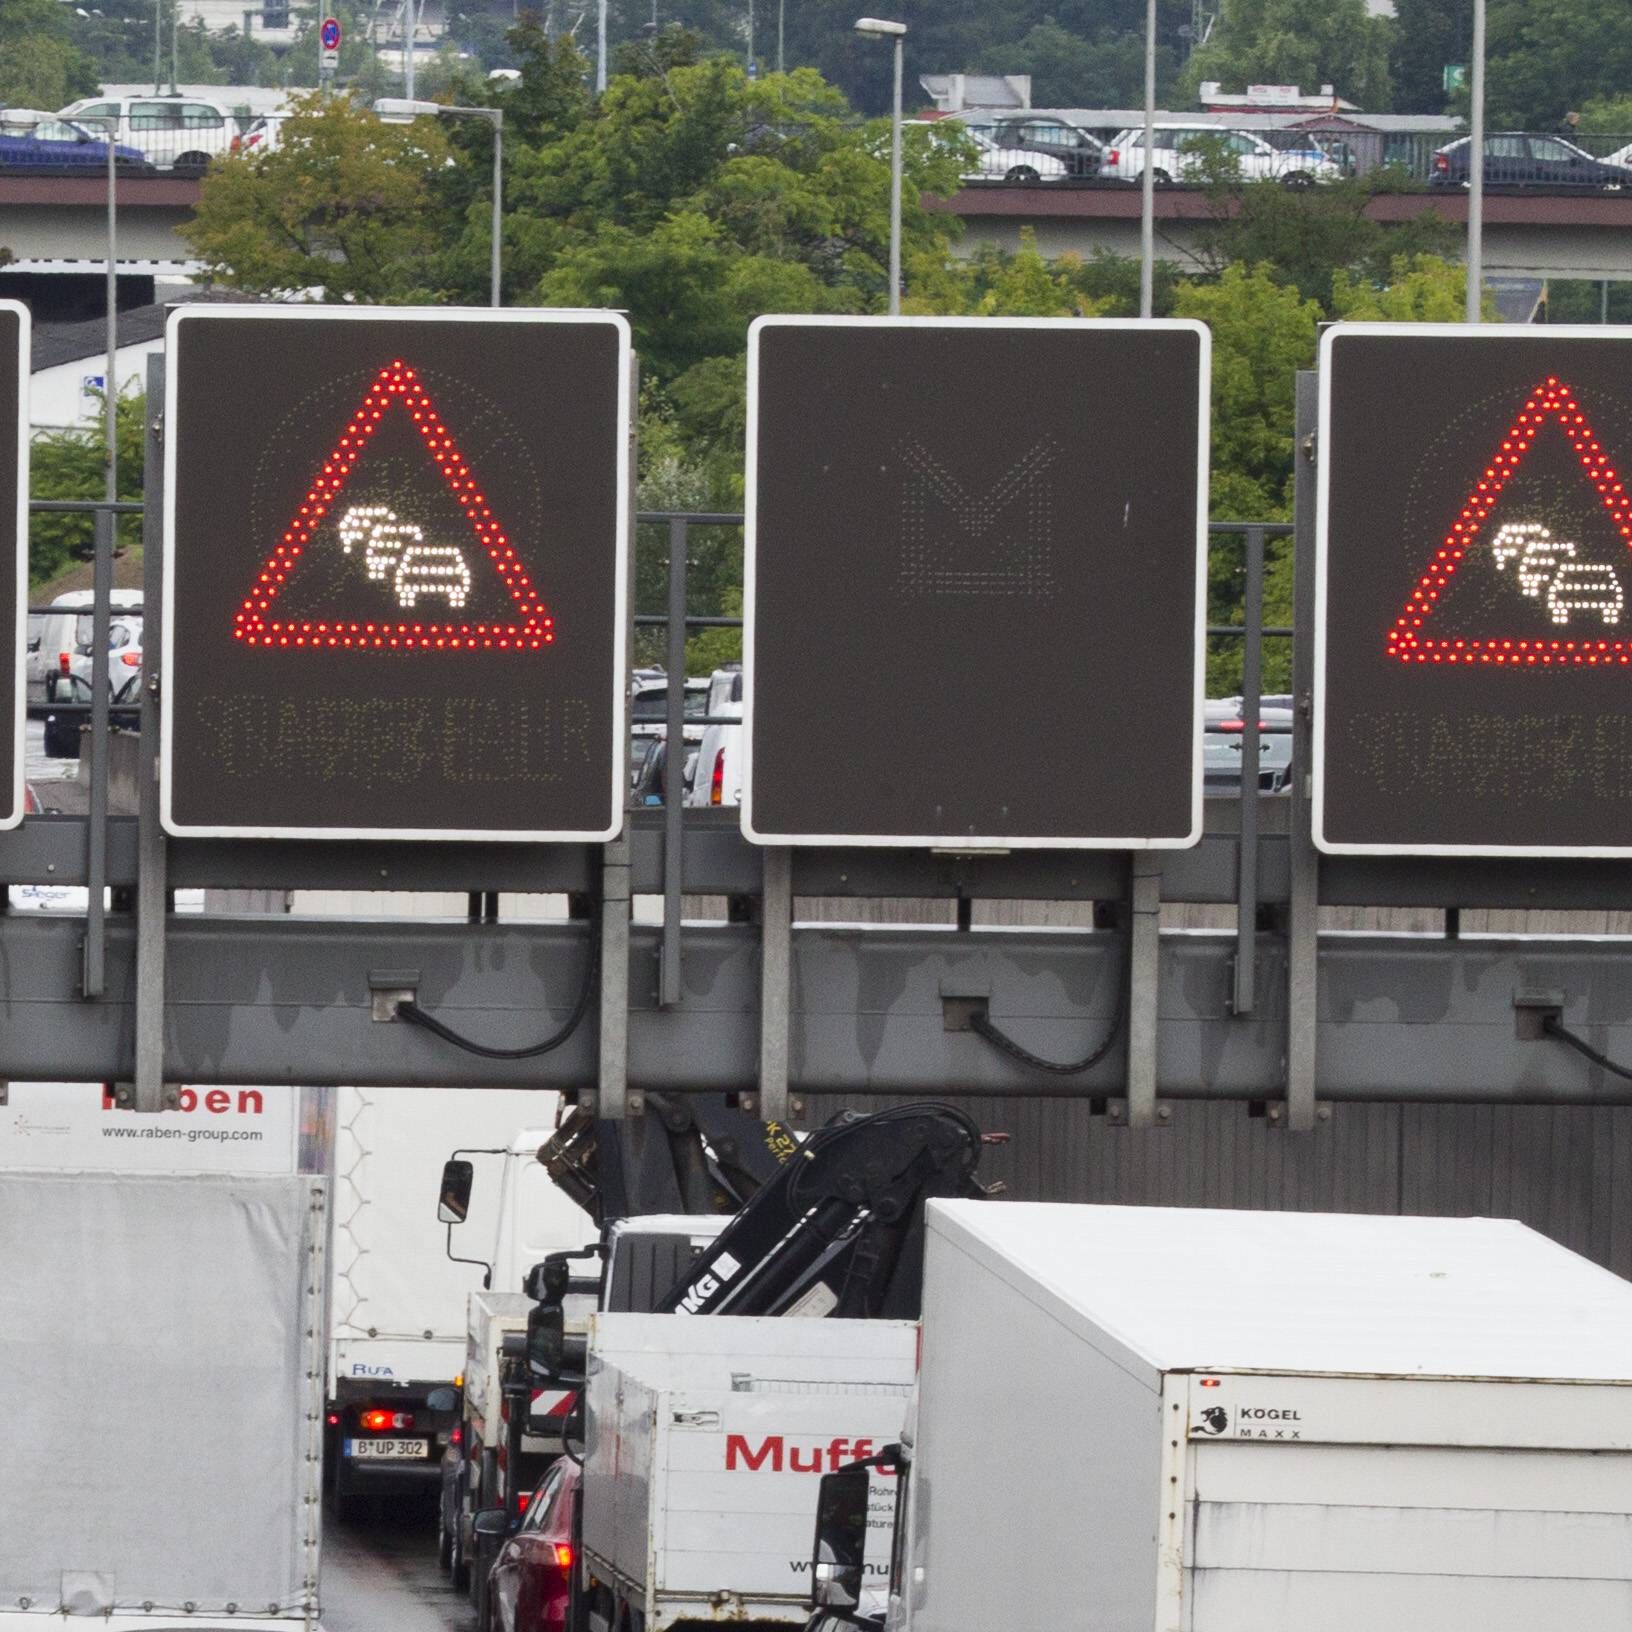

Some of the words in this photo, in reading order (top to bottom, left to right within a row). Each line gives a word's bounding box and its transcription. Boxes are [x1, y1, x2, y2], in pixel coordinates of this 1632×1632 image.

[102, 1125, 263, 1143] www.raben-group.com
[1240, 1407, 1302, 1421] KÖGEL
[1240, 1428, 1301, 1440] MAXX
[357, 1442, 367, 1455] B
[375, 1441, 395, 1455] UP
[398, 1442, 424, 1456] 302
